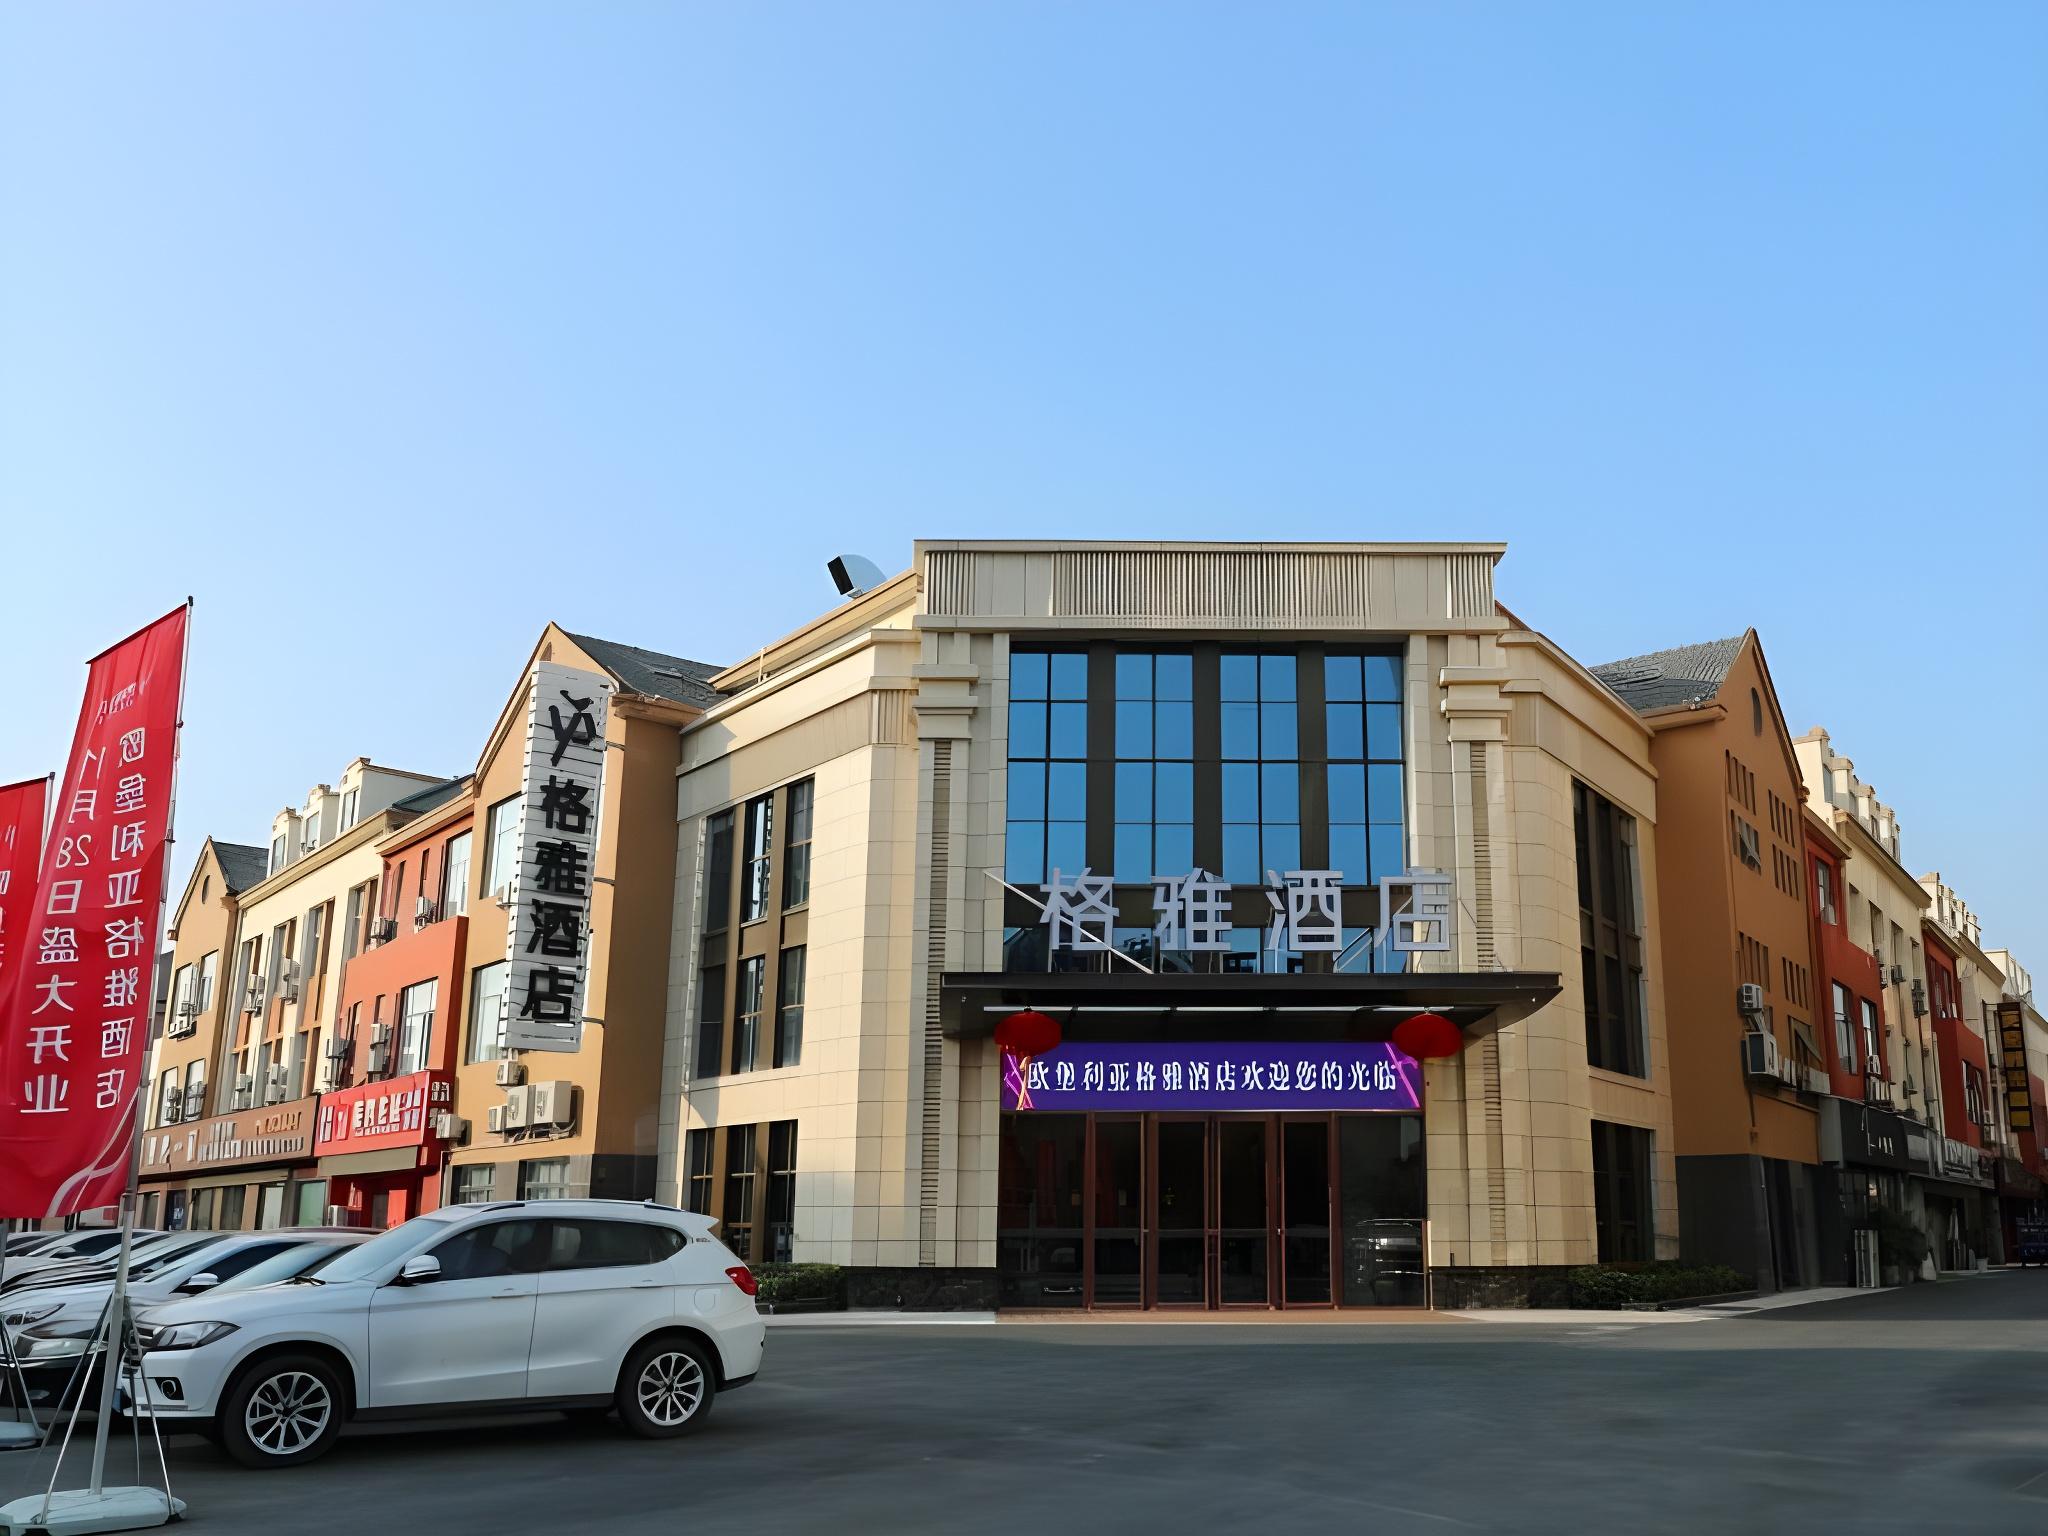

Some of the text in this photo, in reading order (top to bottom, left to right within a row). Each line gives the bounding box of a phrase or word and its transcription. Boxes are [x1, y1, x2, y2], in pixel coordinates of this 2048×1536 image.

[520, 774, 592, 1021] 格雅酒店
[1040, 868, 1452, 951] 格雅酒店
